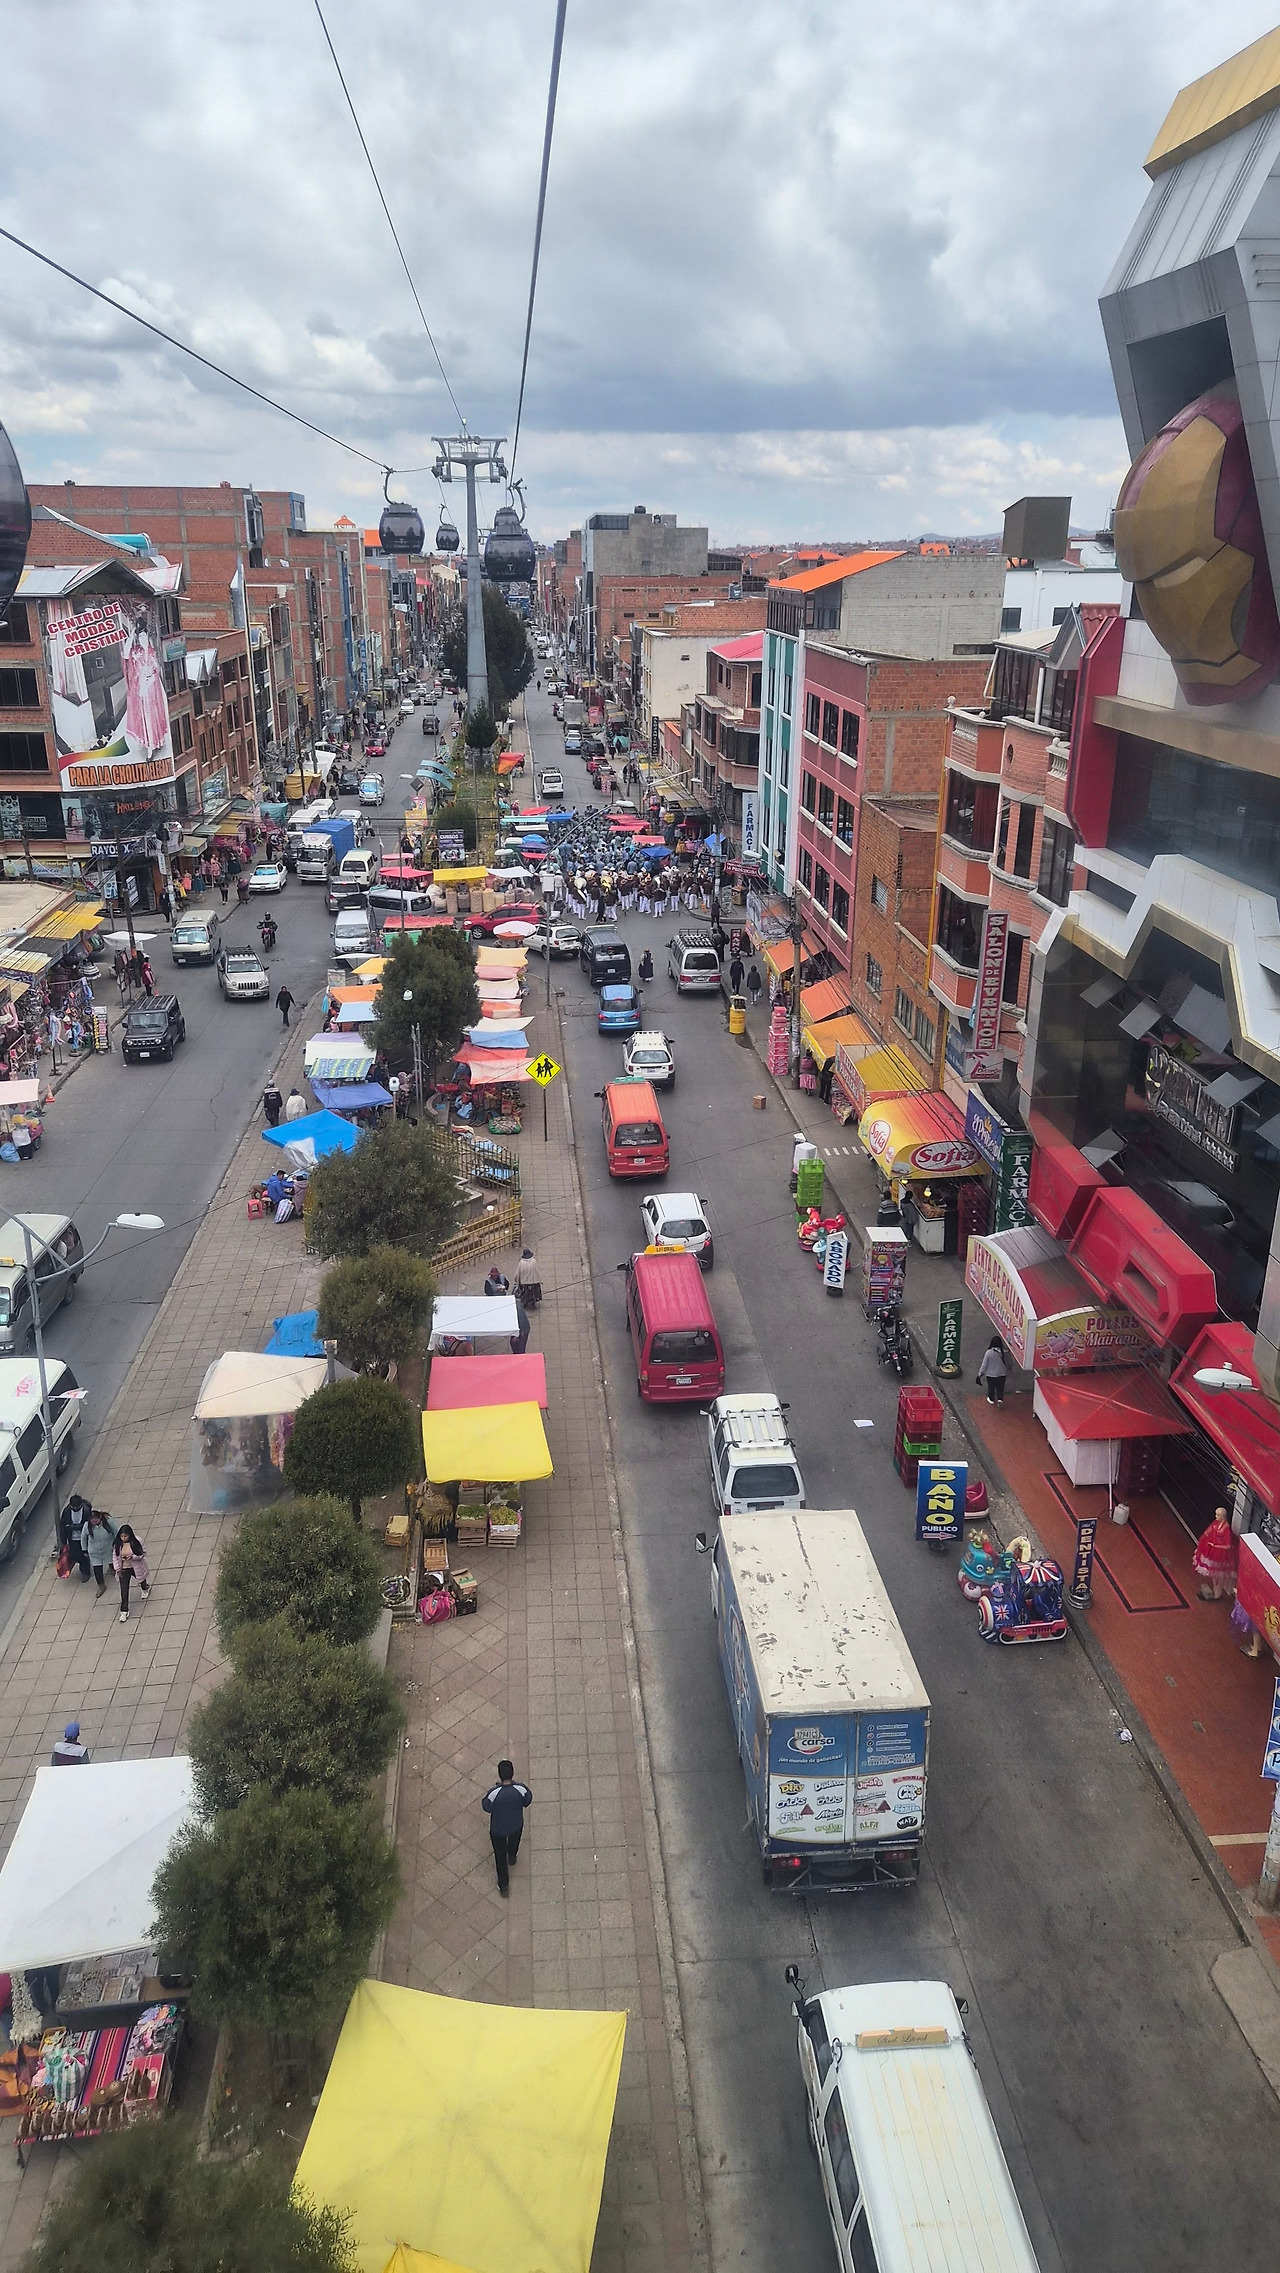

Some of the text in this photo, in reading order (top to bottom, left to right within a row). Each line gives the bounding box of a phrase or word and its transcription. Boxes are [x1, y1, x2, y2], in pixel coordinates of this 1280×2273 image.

[47, 602, 121, 634] CENTRO DE
[65, 619, 116, 643] MODAS
[64, 629, 128, 658] CRISTINA
[68, 766, 98, 786] PARA
[97, 765, 112, 785] LA
[111, 762, 149, 785] CHOLITA
[745, 803, 754, 850] FARMACI
[123, 843, 130, 854] X
[984, 915, 1005, 968] SALON
[985, 968, 1001, 976] DE
[978, 976, 1001, 1048] EVENTOS
[1008, 1154, 1031, 1228] FARMACI
[974, 1240, 992, 1277] VENTA
[992, 1259, 1001, 1288] DE
[1001, 1271, 1025, 1329] POLLOS
[941, 1312, 957, 1365] FARMACIA
[1086, 1314, 1140, 1332] POLLOS
[926, 1468, 957, 1526] BAÑO
[1076, 1528, 1094, 1590] DENTISTA
[801, 1738, 834, 1746] carsa
[860, 1821, 879, 1830] ALFA
